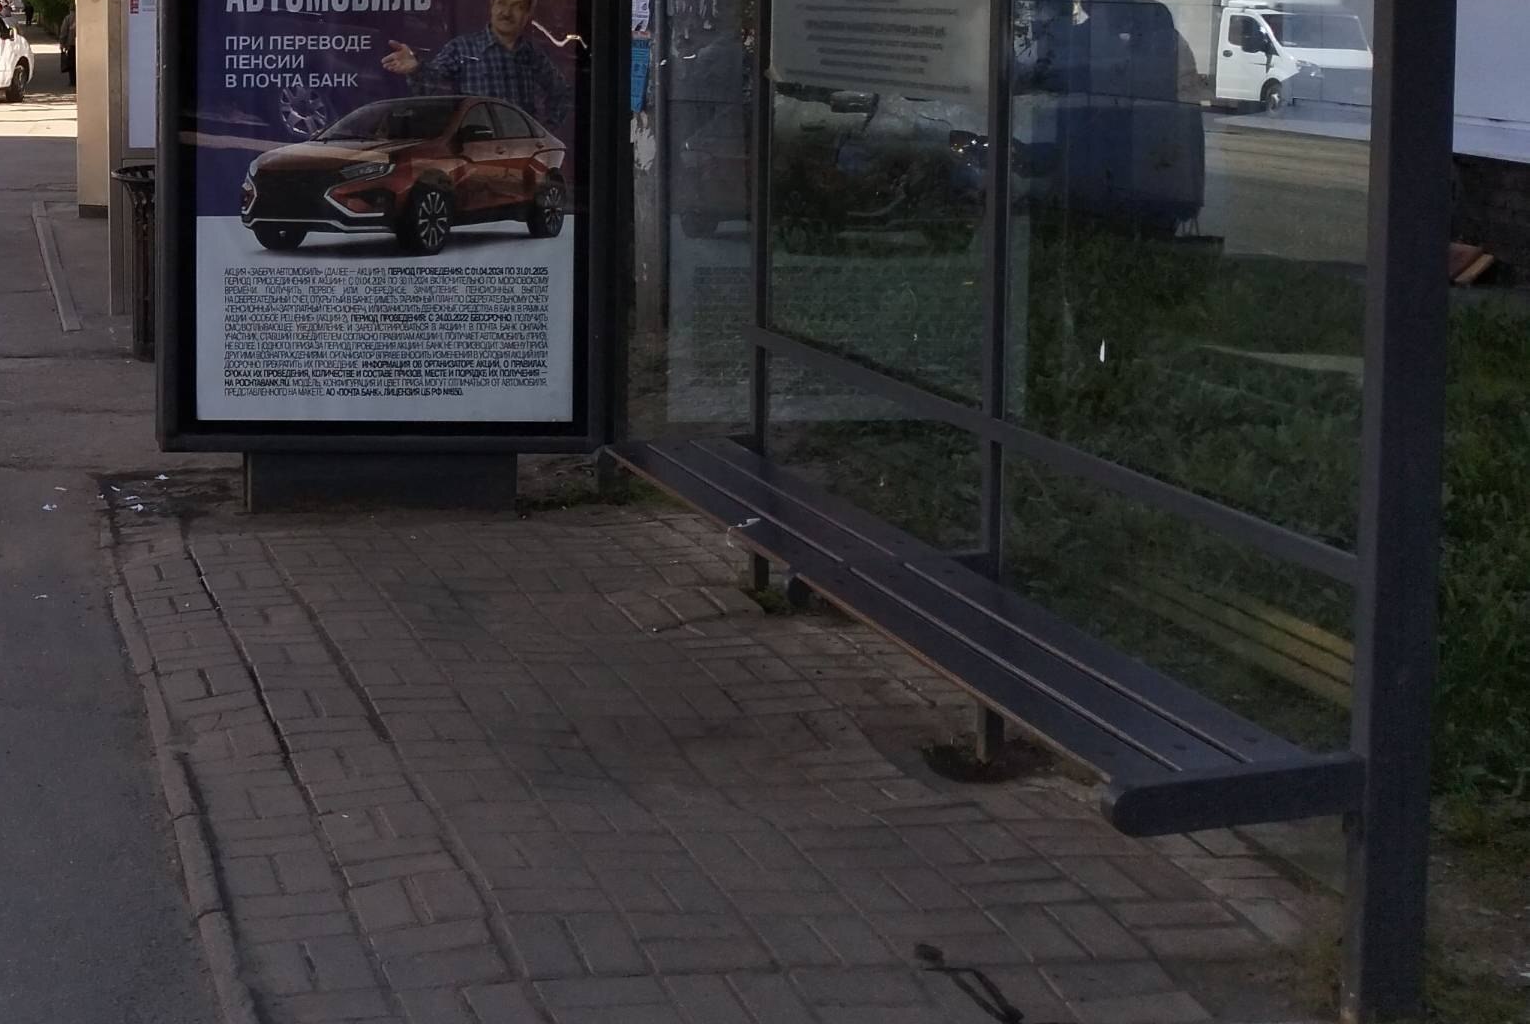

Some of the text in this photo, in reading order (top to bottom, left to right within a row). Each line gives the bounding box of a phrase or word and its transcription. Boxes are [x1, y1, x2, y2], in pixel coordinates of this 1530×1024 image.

[225, 35, 371, 52] ПРИ ПЕРЕВОДЕ
[225, 55, 304, 69] ПЕНСИИ
[225, 73, 358, 88] В ПОЧТА БАНК
